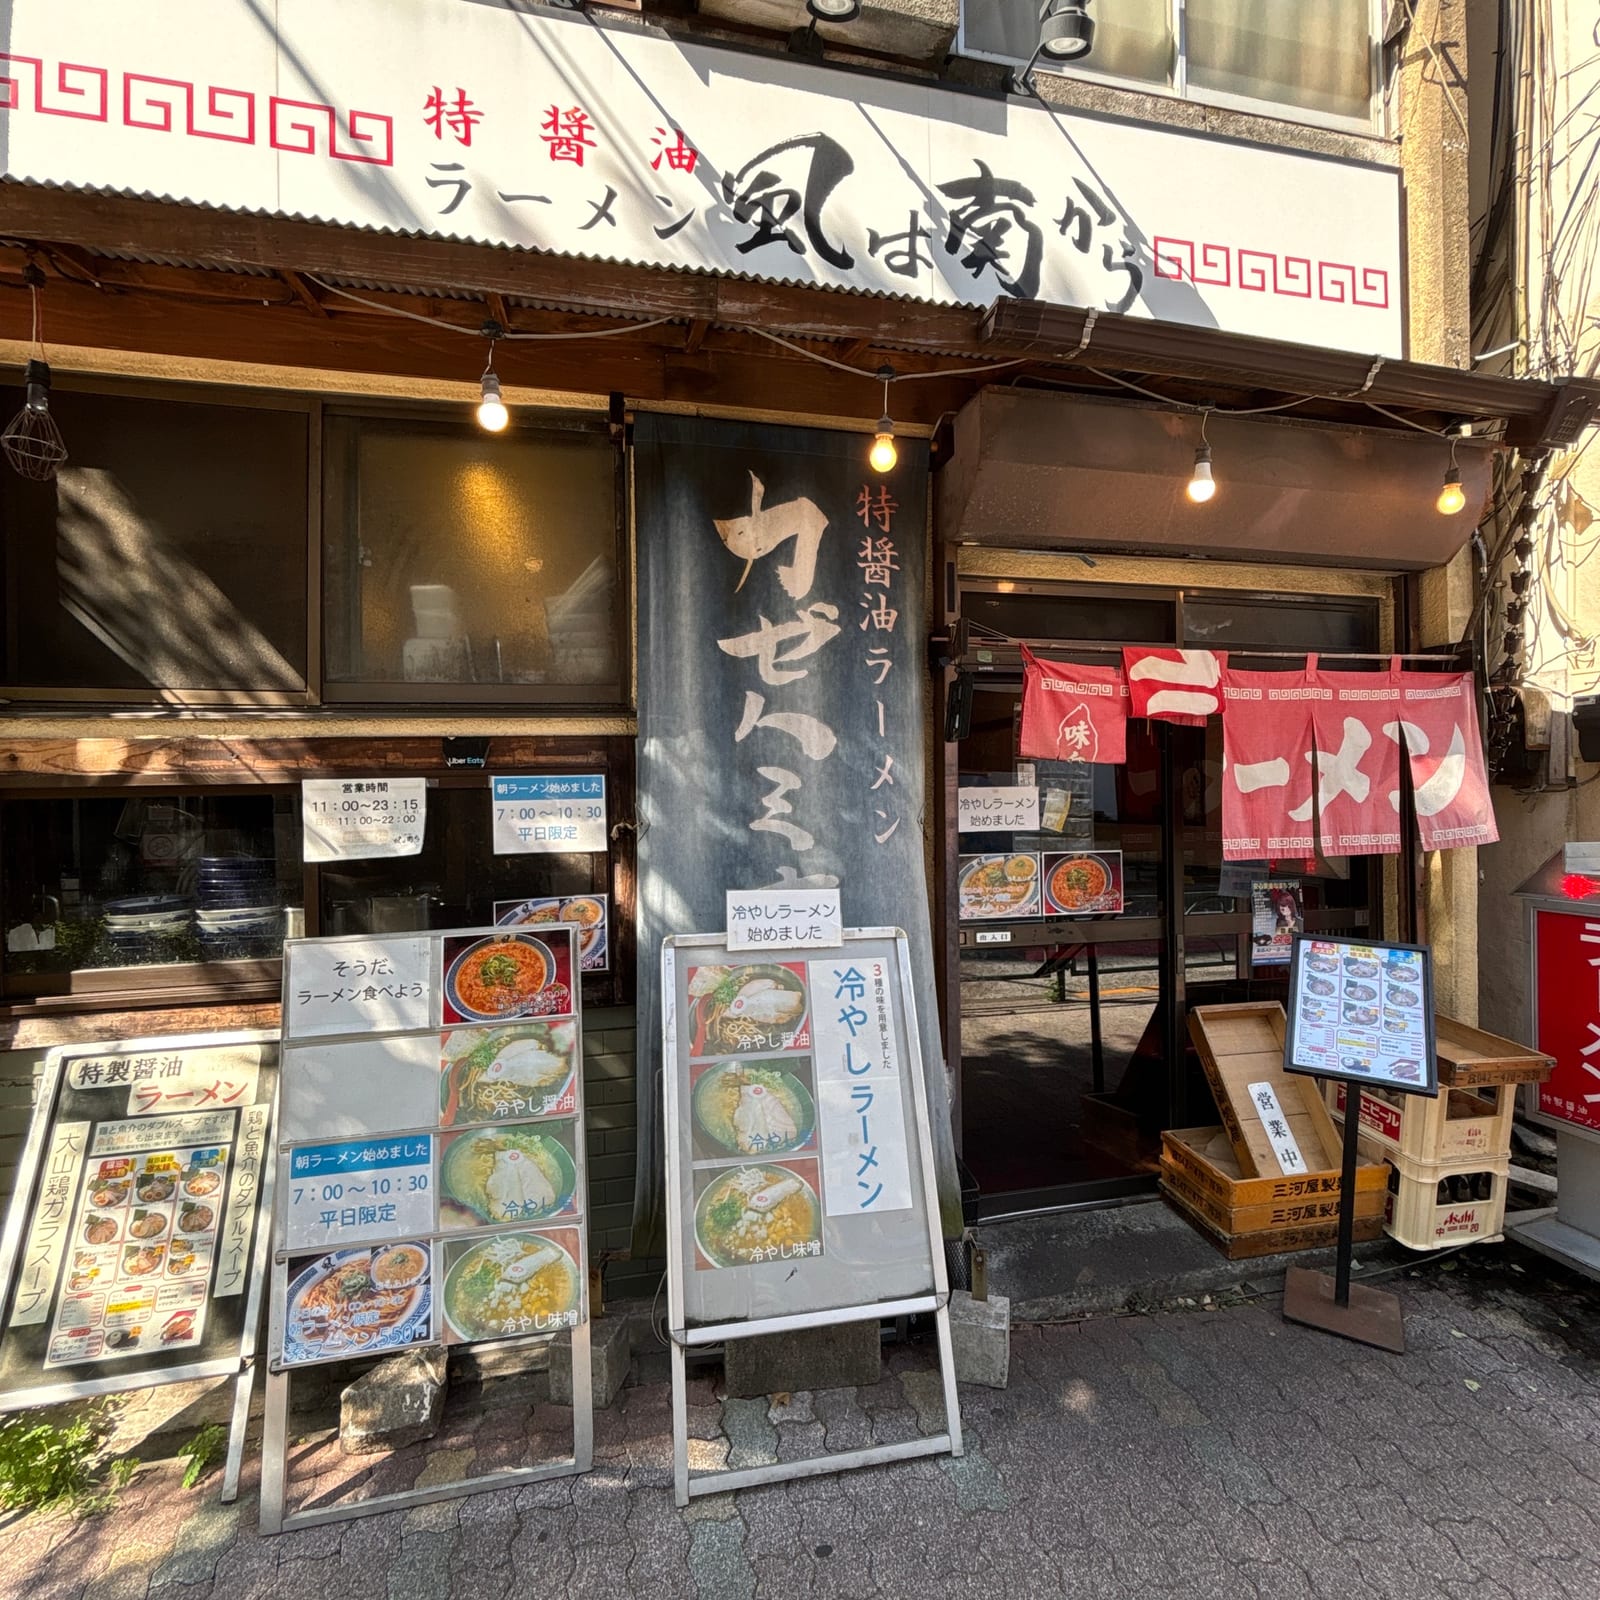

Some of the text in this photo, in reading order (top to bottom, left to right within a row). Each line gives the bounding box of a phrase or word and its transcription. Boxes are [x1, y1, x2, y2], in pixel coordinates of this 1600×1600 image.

[424, 86, 699, 175] 特醤油
[424, 162, 698, 241] ラーメン
[721, 131, 1143, 311] 風は南から
[856, 483, 900, 845] 特醤油ラーメン
[341, 782, 389, 794] 営業時間
[496, 781, 602, 796] 朝ラーメン始めました
[959, 797, 1036, 811] 冷やしラーメン
[517, 825, 579, 841] 平日限定
[969, 814, 1025, 827] 始めました
[731, 903, 837, 921] 冷やしラーメン
[747, 924, 824, 943] 始めました
[332, 958, 395, 978] そうだ、
[297, 981, 424, 1006] ラーメン食べよう
[872, 963, 892, 1070] 3種の味を用意しました
[737, 1031, 810, 1051] 冷やし醤油
[78, 1056, 183, 1085] 特製醤油
[136, 1080, 249, 1112] ラーメン
[833, 966, 883, 1209] 冷やしラーメン
[493, 1092, 576, 1117] 冷やし醤油
[1257, 1091, 1298, 1168] 営業中
[295, 1142, 428, 1170] 朝ラーメン始めました
[223, 1110, 263, 1289] 鶏と魚介のダブルスープ
[19, 1133, 81, 1315] 大山鶏ガラスープ
[319, 1204, 397, 1229] 平日限定
[1443, 1208, 1476, 1226] Asahi
[1435, 1226, 1445, 1237] 中
[1469, 1222, 1480, 1233] 20
[749, 1239, 821, 1263] 冷やし味噌
[501, 1309, 579, 1334] 冷やし味噌
